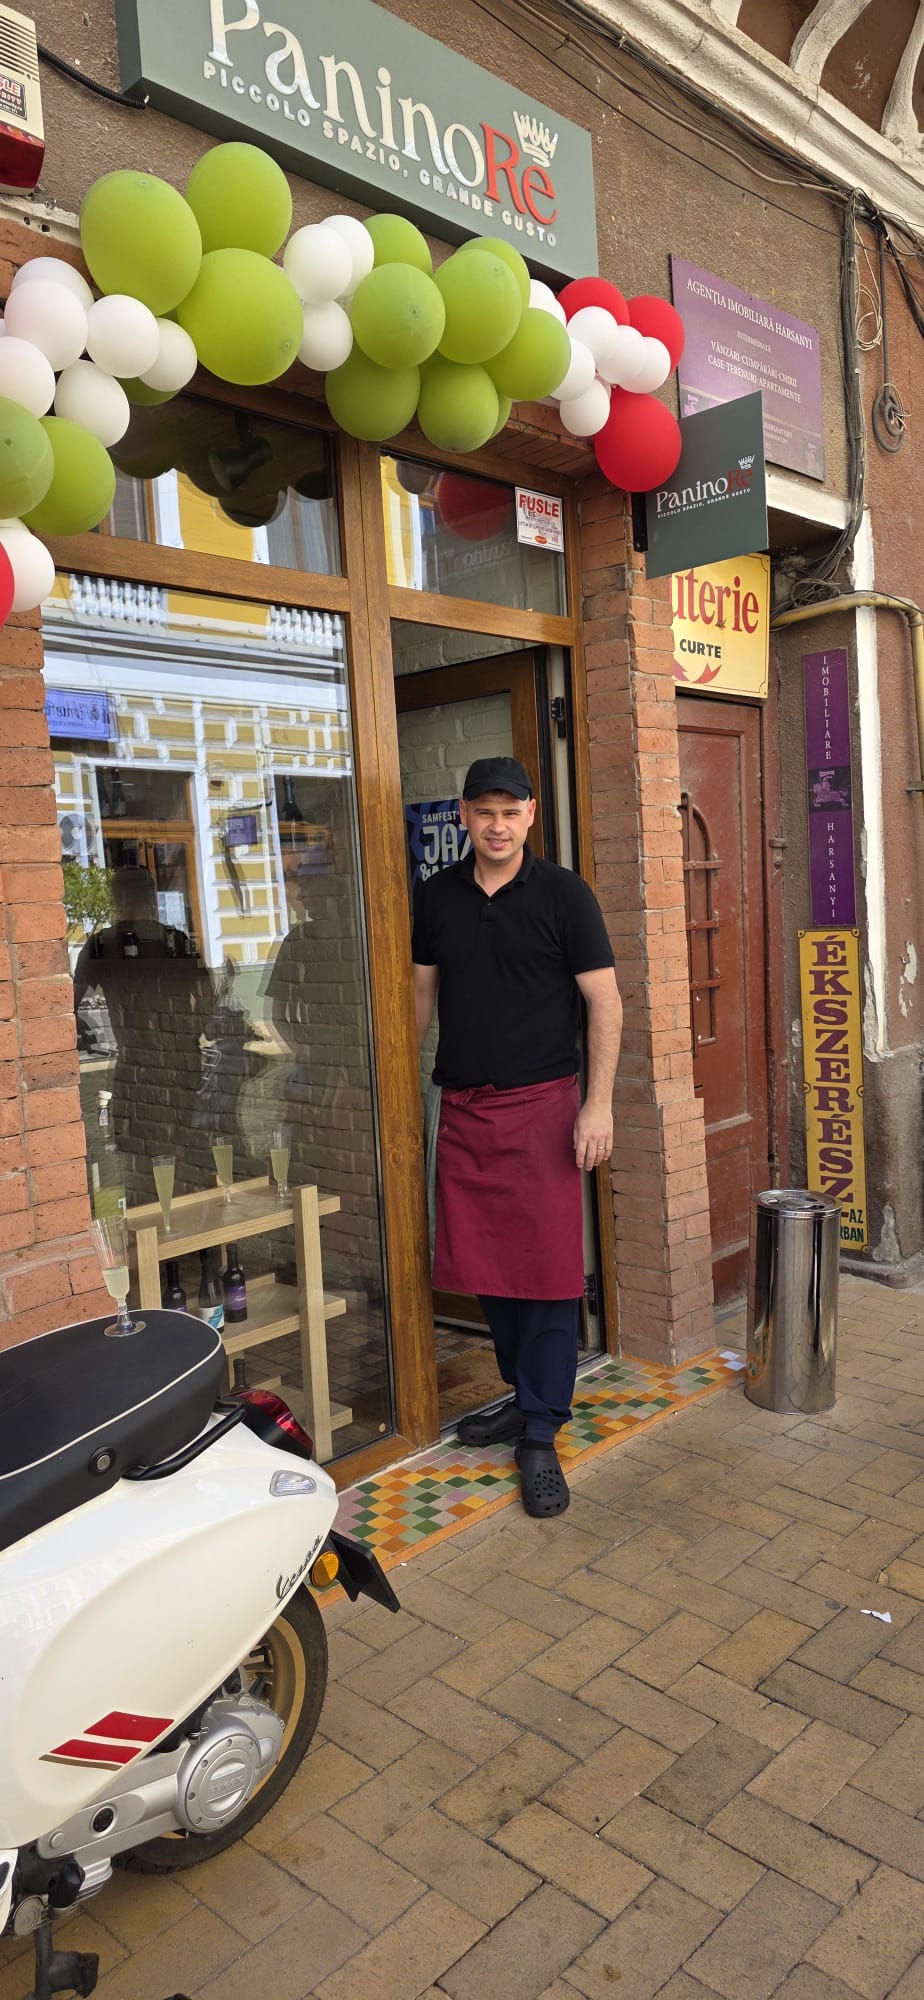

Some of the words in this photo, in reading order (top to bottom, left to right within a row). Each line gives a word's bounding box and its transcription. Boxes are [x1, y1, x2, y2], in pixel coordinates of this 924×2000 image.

[203, 60, 311, 127] PICCOLO
[322, 120, 408, 178] SPAZIO,
[418, 169, 494, 217] GRANDE
[501, 210, 557, 247] GUSTO
[208, 0, 559, 226] PaninoRe
[727, 298, 774, 332] IMOBILIARĂ
[519, 493, 560, 518] FUSLE
[656, 469, 753, 513] PaninoRe
[679, 638, 722, 659] CURTE
[821, 655, 832, 760] IMOBILIARE
[827, 822, 837, 918] HARSANYI
[809, 935, 854, 1203] ÉKSZERÉSZ
[274, 1535, 323, 1609] Vespa
